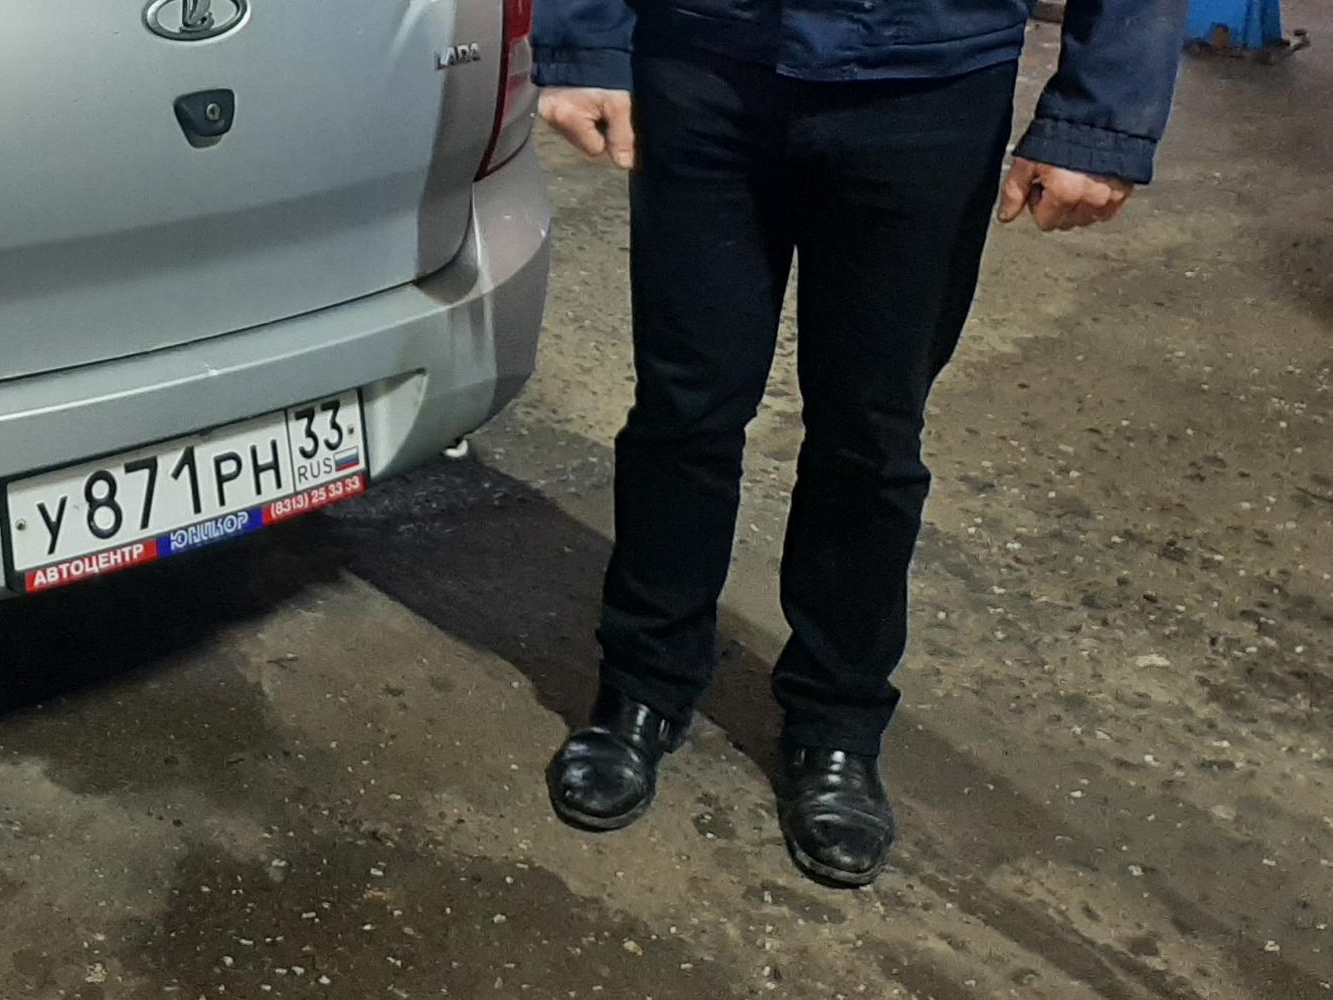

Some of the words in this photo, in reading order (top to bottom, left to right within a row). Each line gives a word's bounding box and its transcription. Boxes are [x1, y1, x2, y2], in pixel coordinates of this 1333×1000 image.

[37, 438, 283, 556] У871РН
[294, 399, 344, 460] 33
[297, 456, 334, 484] RUS
[33, 544, 145, 588] АВТОЦЕНТР
[270, 492, 309, 519] (8313)
[311, 487, 327, 504] 25
[328, 481, 344, 497] 33
[345, 475, 360, 492] 33
